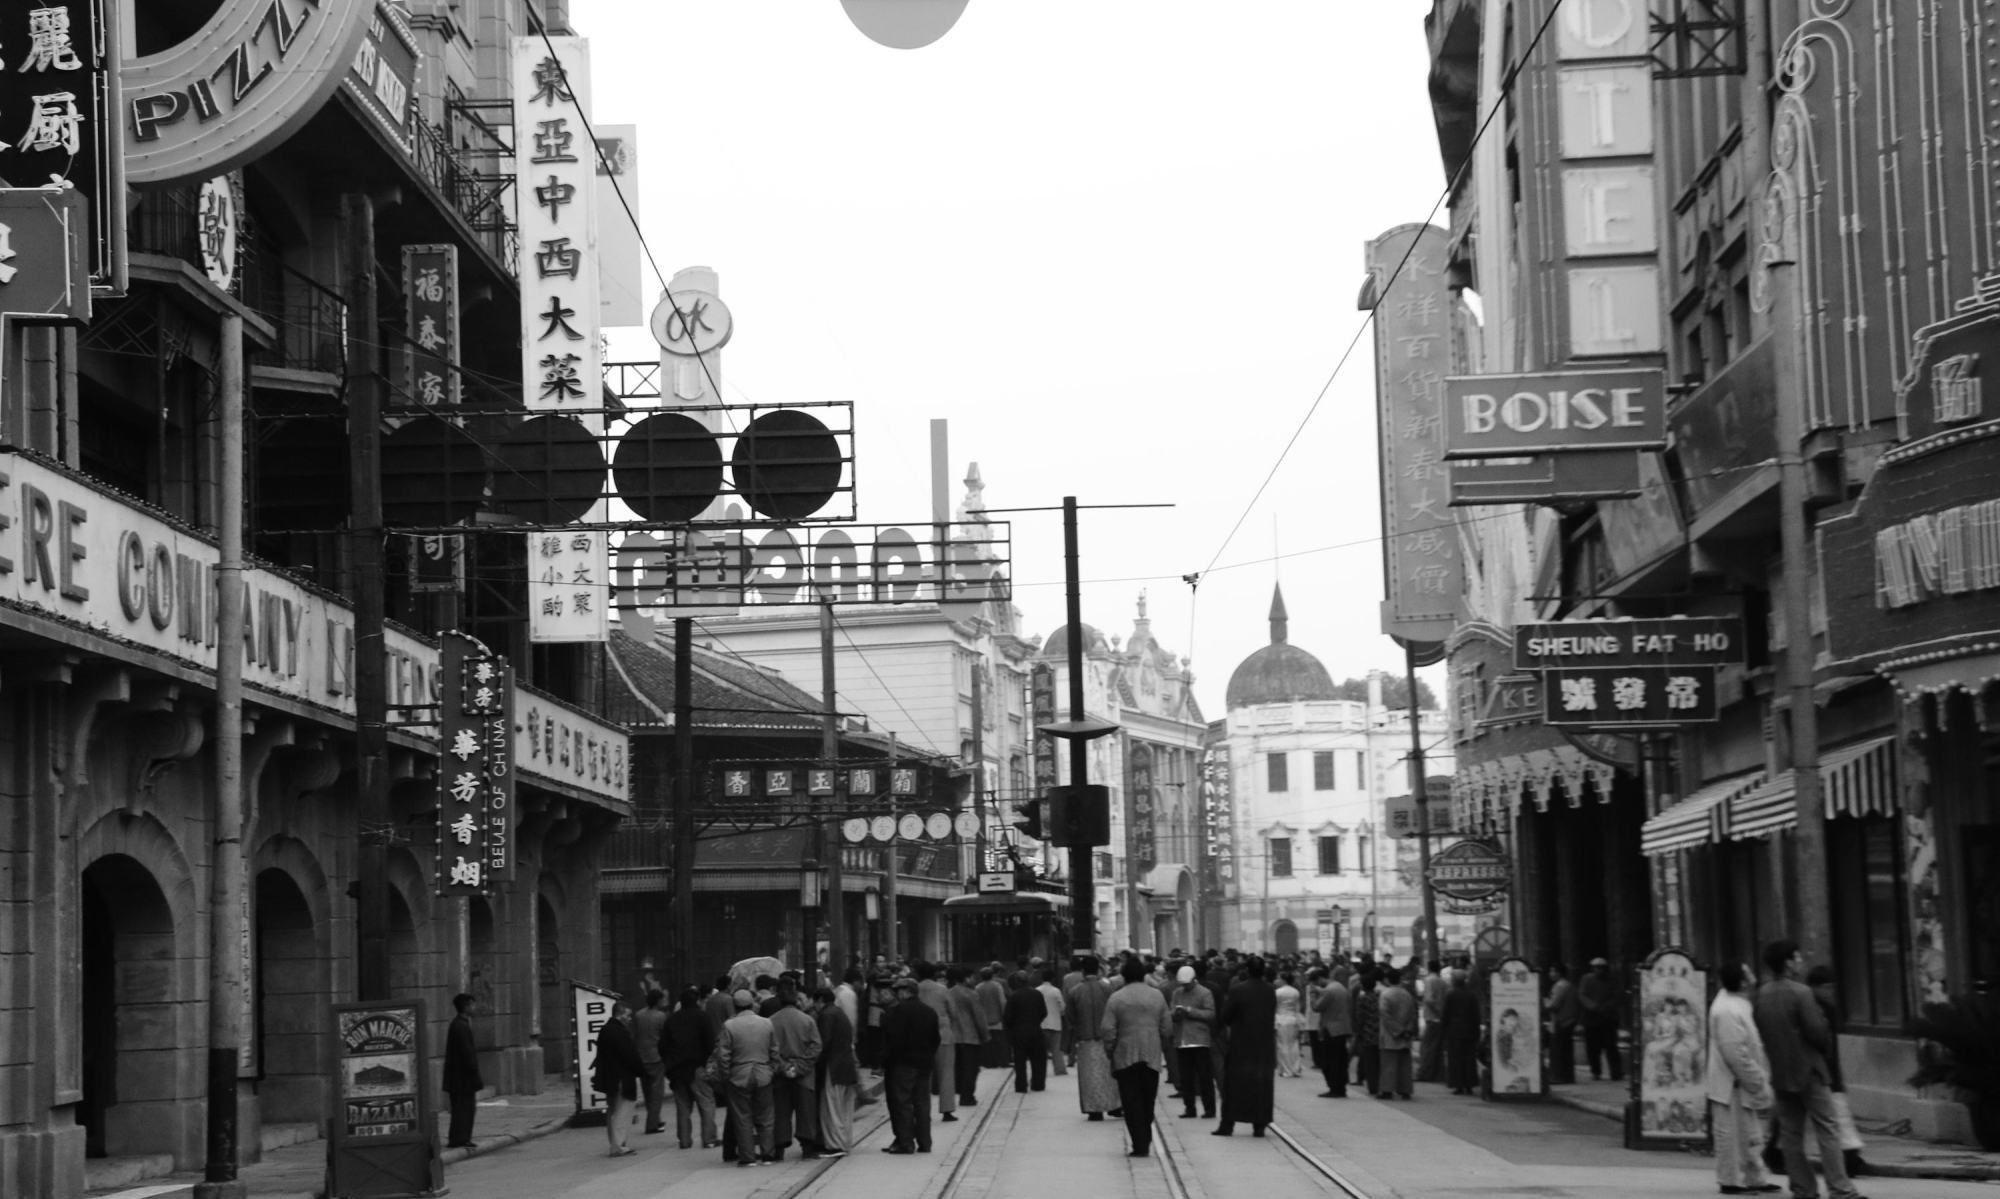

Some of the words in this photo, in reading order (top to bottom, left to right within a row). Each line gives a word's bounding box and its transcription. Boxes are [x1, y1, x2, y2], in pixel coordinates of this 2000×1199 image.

[131, 0, 320, 142] PIZZ
[18, 7, 84, 190] 麗厨
[528, 56, 587, 404] 東亞中西大菜
[414, 268, 447, 562] 福泰家司
[1462, 387, 1646, 434] BOISE
[1527, 635, 1619, 658] SHEUNG
[1633, 634, 1677, 653] FAT
[1694, 633, 1729, 651] HO
[492, 786, 506, 809] OF
[727, 768, 915, 795] 香亞玉蘭霜
[450, 729, 481, 888] 華芳香烟
[1436, 866, 1505, 879] ESPRESSO
[369, 1019, 411, 1046] MARCHE
[347, 1101, 416, 1124] BAZAAR
